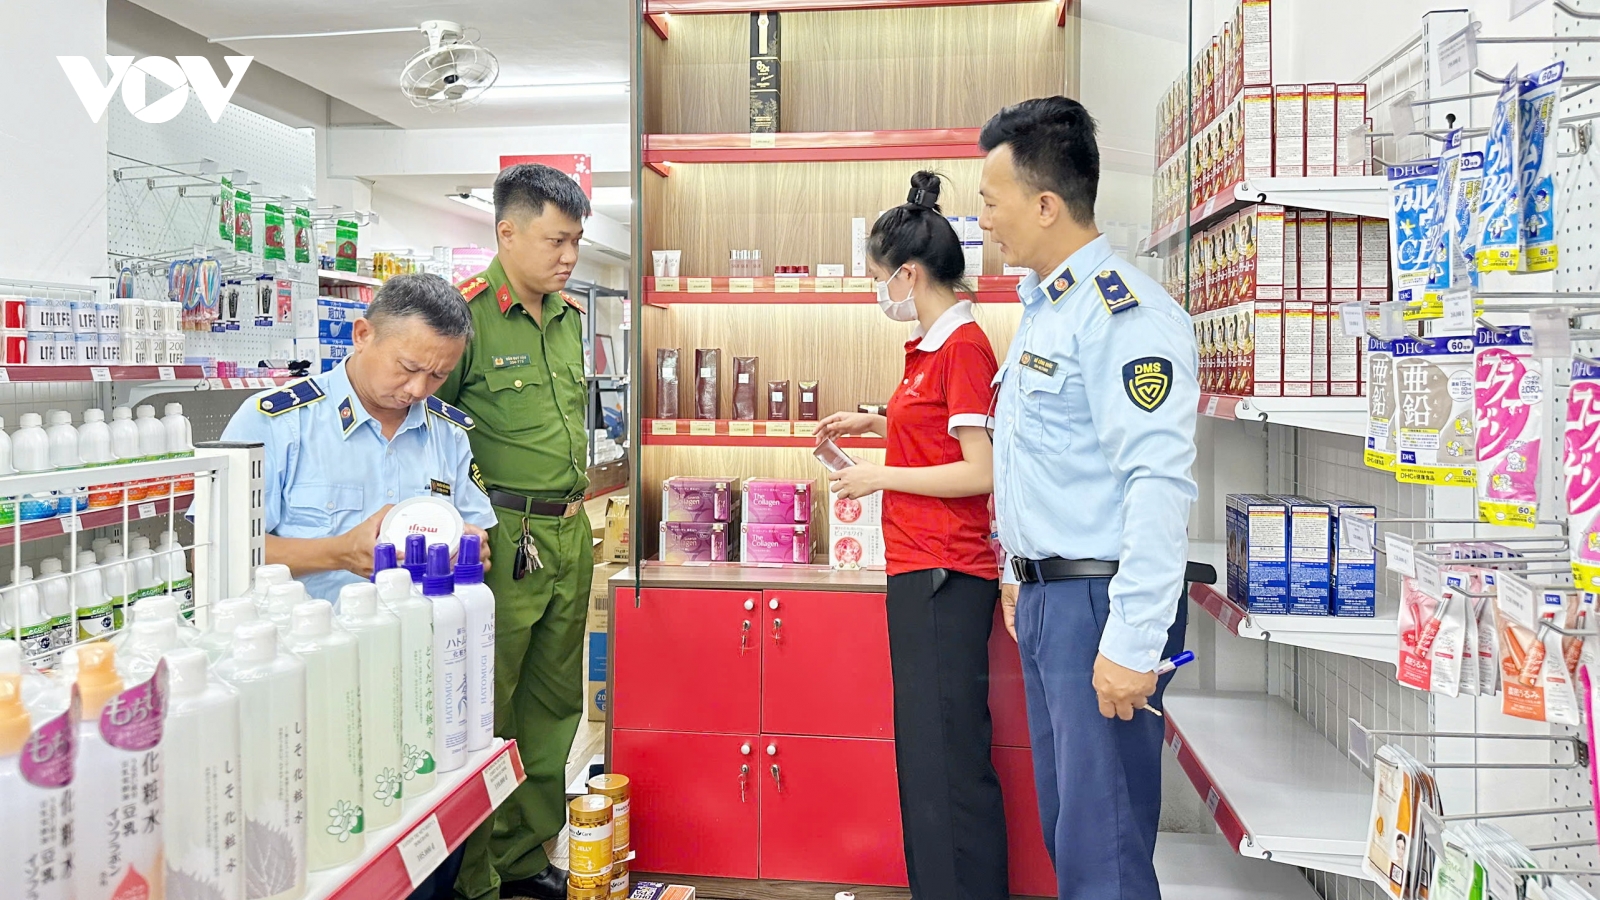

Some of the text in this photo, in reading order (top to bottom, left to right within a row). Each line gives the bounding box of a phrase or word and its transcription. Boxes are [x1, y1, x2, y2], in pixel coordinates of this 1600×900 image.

[169, 342, 184, 351] 200
[1396, 342, 1424, 354] DHC
[170, 352, 183, 364] LIFE
[1134, 362, 1162, 375] DMS
[1401, 361, 1432, 427] 亜鉛
[753, 499, 780, 507] Collagen
[408, 524, 438, 533] meiji
[752, 540, 778, 548] Collagen
[142, 750, 160, 834] 化粧水
